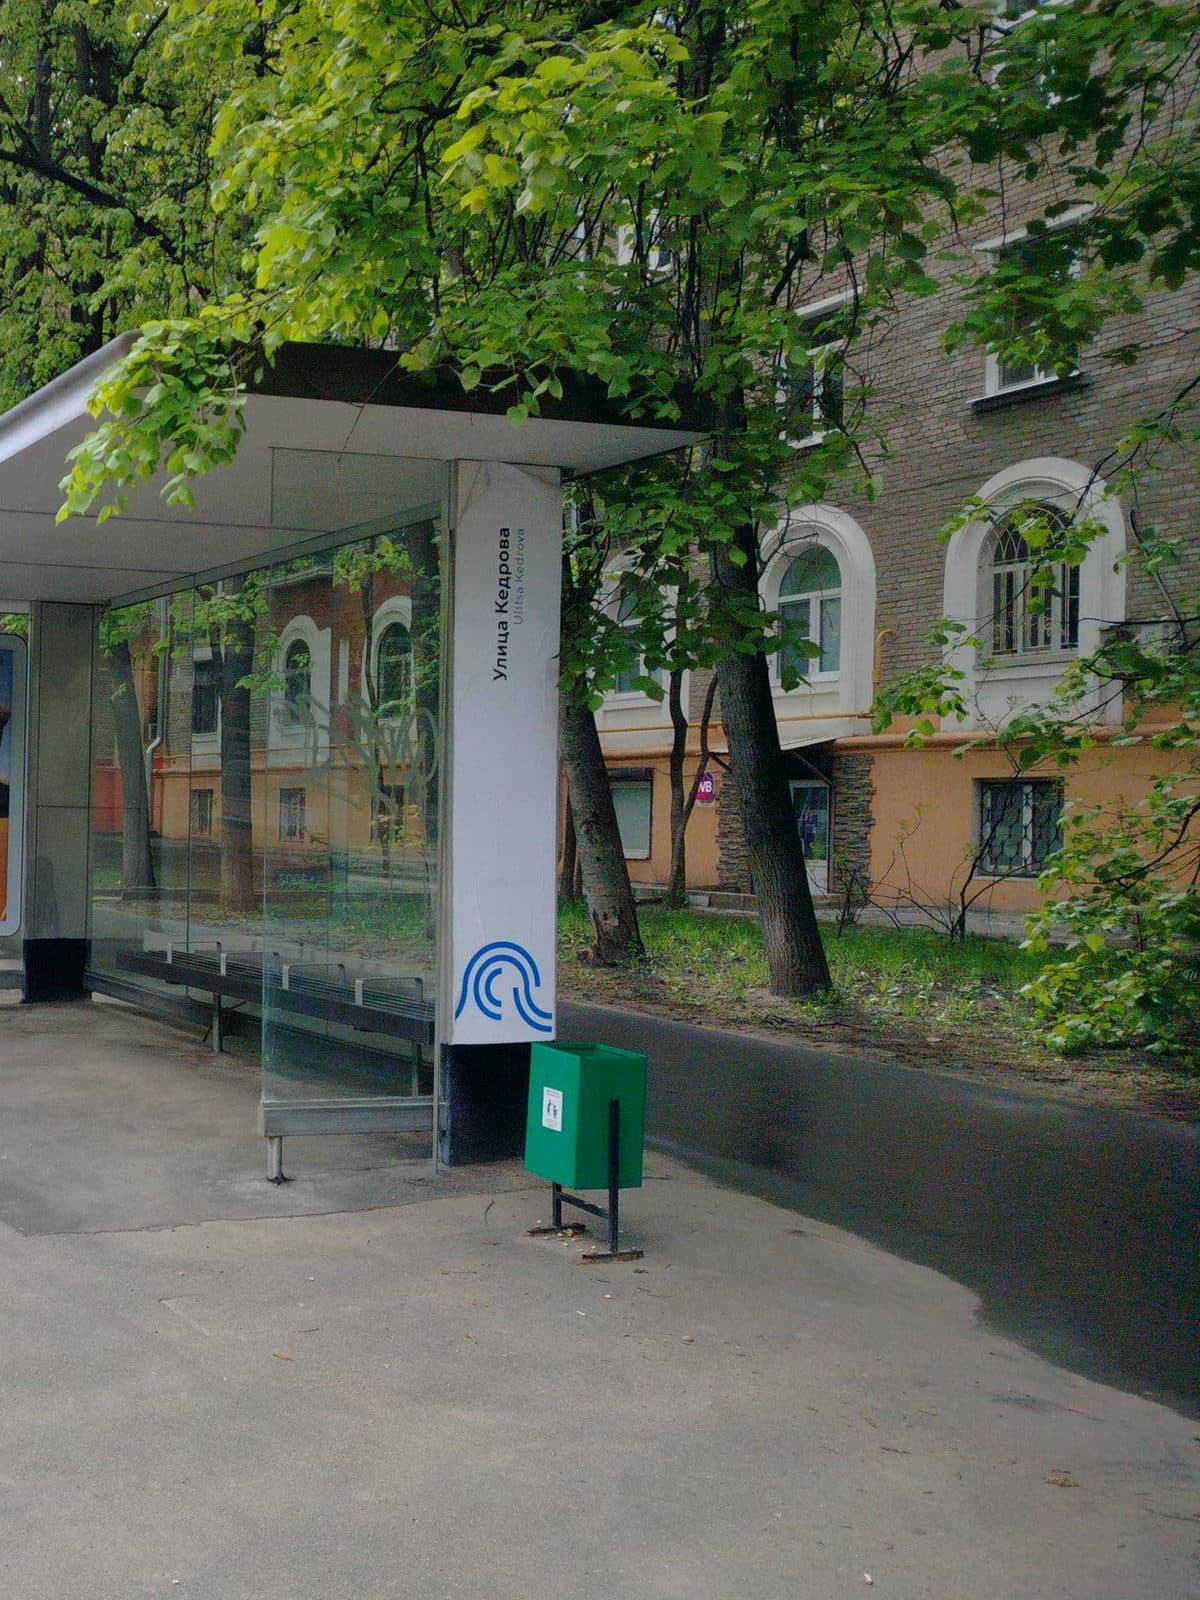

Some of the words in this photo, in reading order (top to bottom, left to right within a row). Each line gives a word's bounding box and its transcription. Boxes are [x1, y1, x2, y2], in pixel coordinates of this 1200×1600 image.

[494, 527, 512, 614] Кедрова
[515, 528, 525, 581] Kedrova
[513, 586, 524, 625] Ulitsa
[493, 620, 510, 681] Улица
